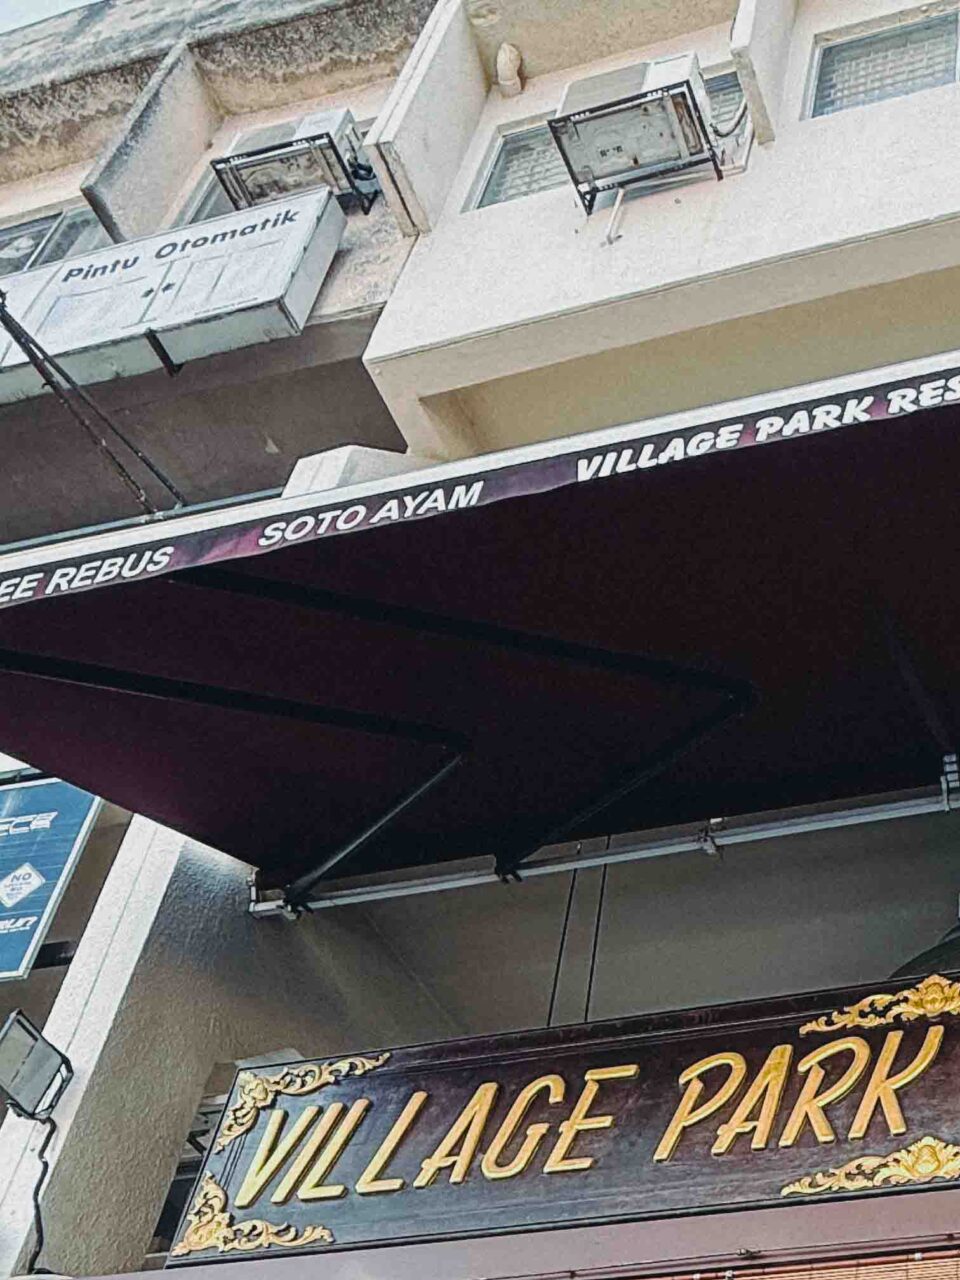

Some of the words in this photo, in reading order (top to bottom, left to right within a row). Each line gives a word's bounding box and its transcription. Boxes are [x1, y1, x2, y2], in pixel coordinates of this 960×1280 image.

[61, 255, 141, 283] Pintu
[154, 208, 300, 260] Otomatik
[576, 422, 744, 482] VILLAGE
[754, 396, 874, 442] PARK
[258, 504, 367, 547] SOTO
[370, 481, 486, 523] AYAM
[45, 546, 174, 595] REBUS
[234, 1063, 640, 1209] VILLAGE
[654, 1023, 943, 1163] PARK
